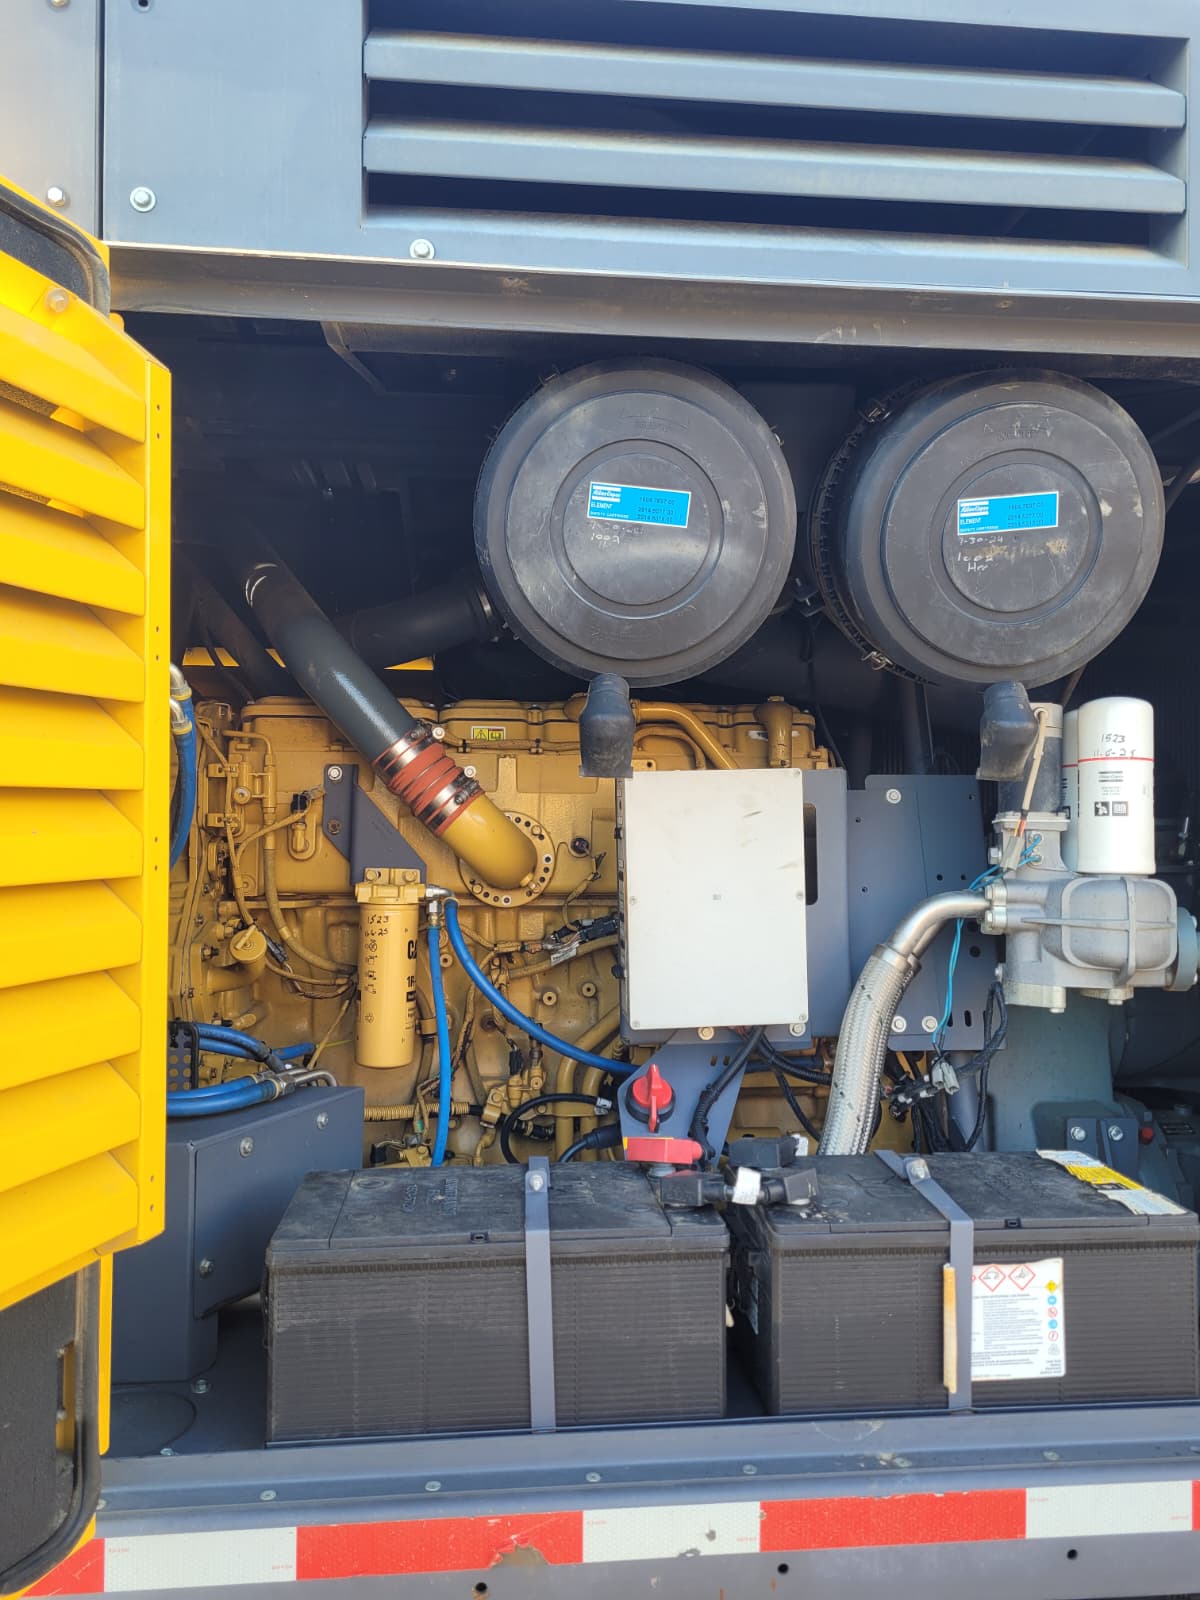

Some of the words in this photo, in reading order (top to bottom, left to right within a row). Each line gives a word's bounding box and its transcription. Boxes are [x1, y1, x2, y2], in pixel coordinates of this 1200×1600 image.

[590, 501, 613, 509] ELEMENT
[1101, 733, 1126, 744] 1523
[367, 914, 389, 925] 1523
